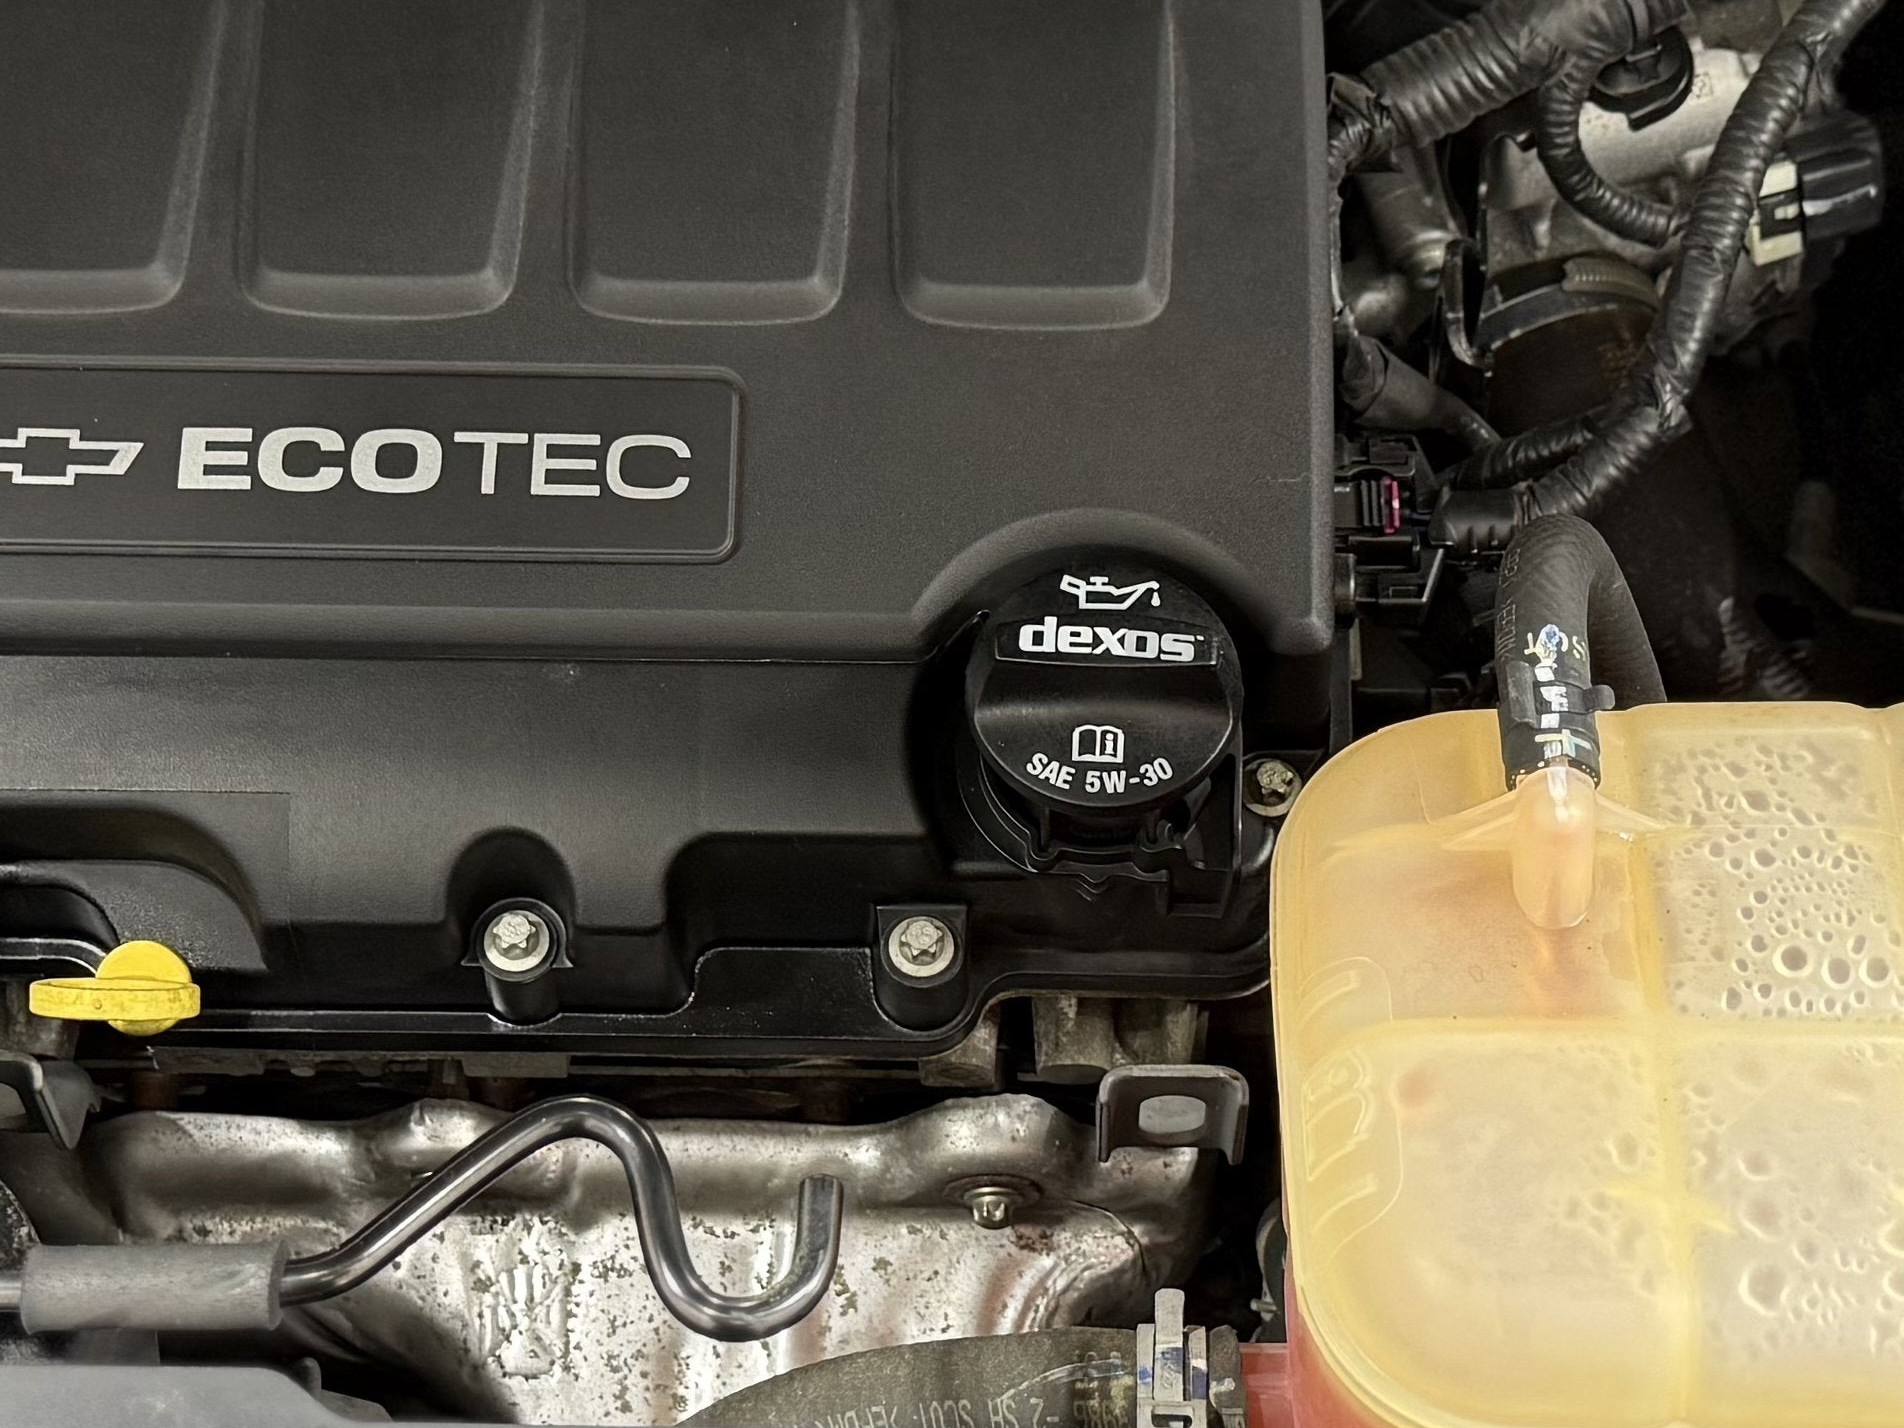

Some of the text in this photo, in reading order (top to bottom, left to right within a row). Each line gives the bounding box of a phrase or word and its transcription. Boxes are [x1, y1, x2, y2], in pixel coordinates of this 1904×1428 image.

[177, 426, 693, 500] ECOTEC
[1019, 616, 1195, 662] dexos
[1026, 752, 1174, 794] SAE 5W-30
